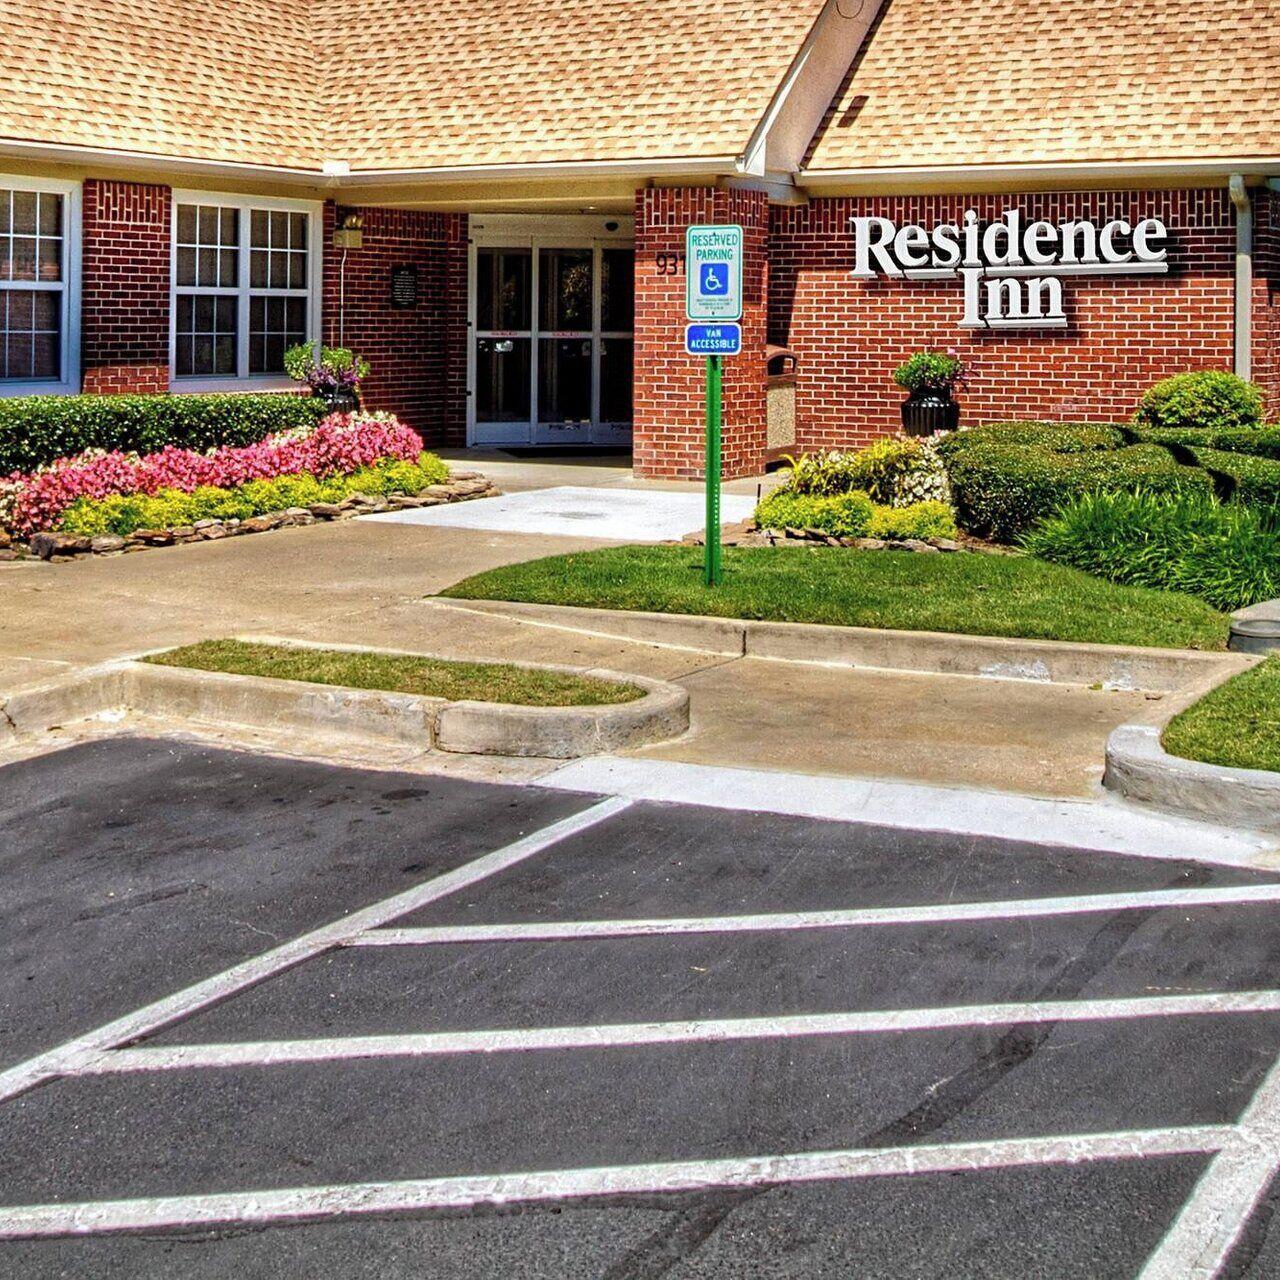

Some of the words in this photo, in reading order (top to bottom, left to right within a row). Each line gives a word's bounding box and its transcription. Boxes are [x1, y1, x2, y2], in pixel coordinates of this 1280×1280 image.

[692, 234, 738, 246] RESERVED
[849, 209, 1168, 279] Residence
[696, 248, 733, 260] PARKING
[957, 268, 1067, 328] Inn
[706, 329, 722, 337] VAN
[691, 339, 736, 348] ACCESSIBLE
